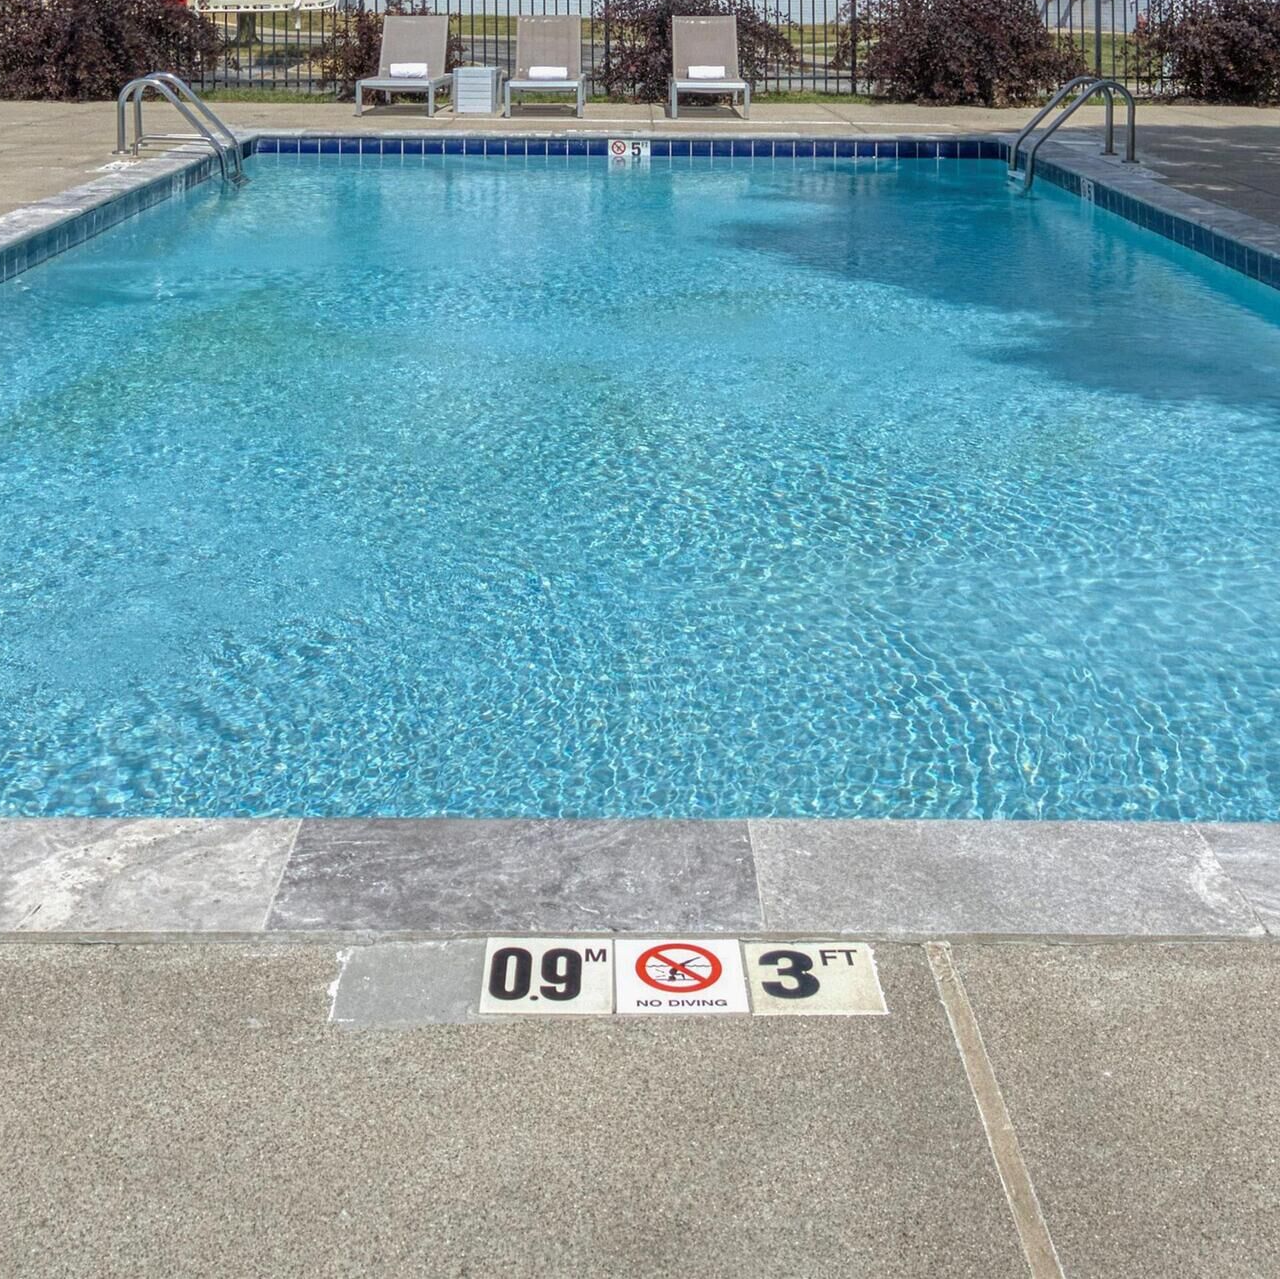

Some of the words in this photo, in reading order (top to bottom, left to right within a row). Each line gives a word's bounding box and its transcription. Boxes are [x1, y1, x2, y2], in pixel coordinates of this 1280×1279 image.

[631, 142, 641, 156] 5
[488, 946, 583, 1001] 0.9
[758, 949, 820, 1000] 3
[819, 949, 857, 966] FT
[636, 999, 663, 1008] NO
[668, 998, 728, 1008] DIVING
